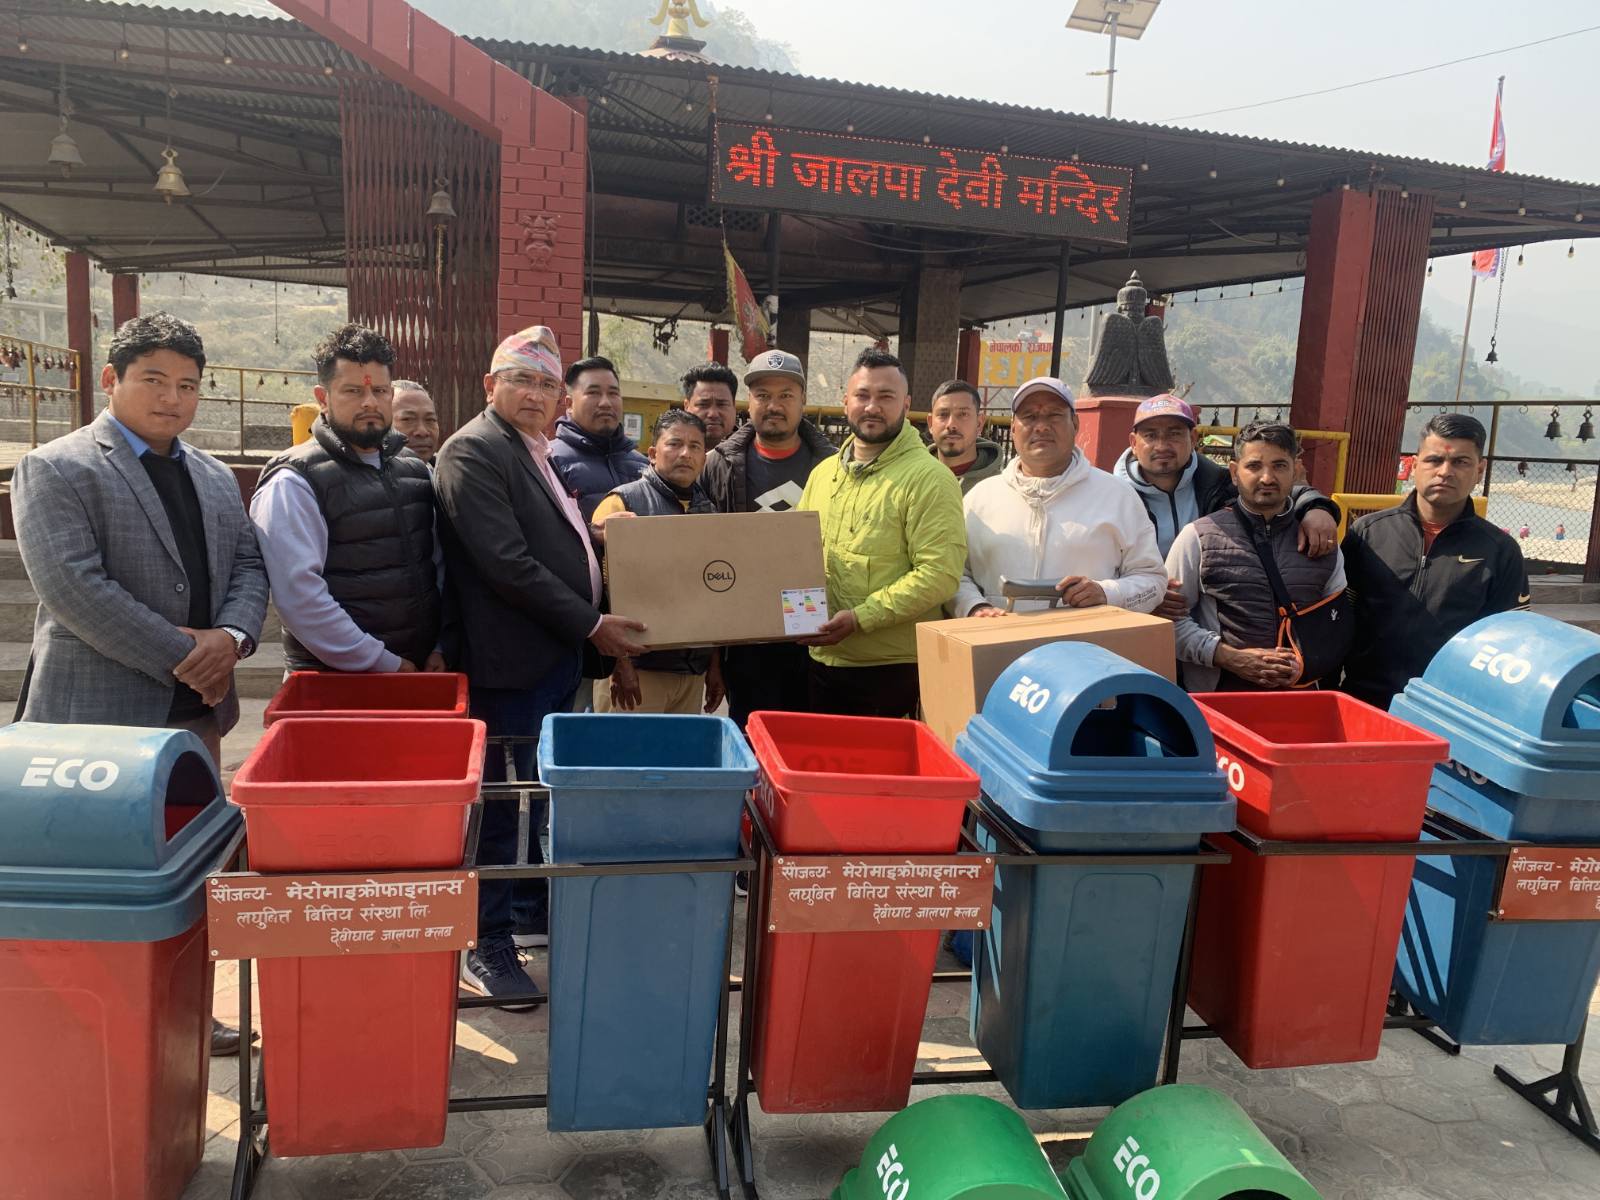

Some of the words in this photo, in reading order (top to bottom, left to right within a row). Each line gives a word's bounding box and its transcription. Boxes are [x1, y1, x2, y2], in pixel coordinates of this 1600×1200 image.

[726, 130, 782, 188] श्री
[790, 152, 927, 201] जालपा
[936, 151, 1009, 210] देवी
[1017, 164, 1124, 223] मन्दिर
[1027, 342, 1053, 354] राजधा
[707, 572, 733, 581] DELL
[1469, 644, 1532, 685] ECO
[1008, 675, 1051, 714] ECO
[20, 756, 120, 791] ECO
[896, 883, 935, 901] संस्था
[360, 903, 404, 922] संस्था
[915, 906, 953, 921] जालपा
[381, 927, 422, 942] जालपा
[876, 1143, 910, 1200] ECO
[1113, 1135, 1161, 1200] ECO
